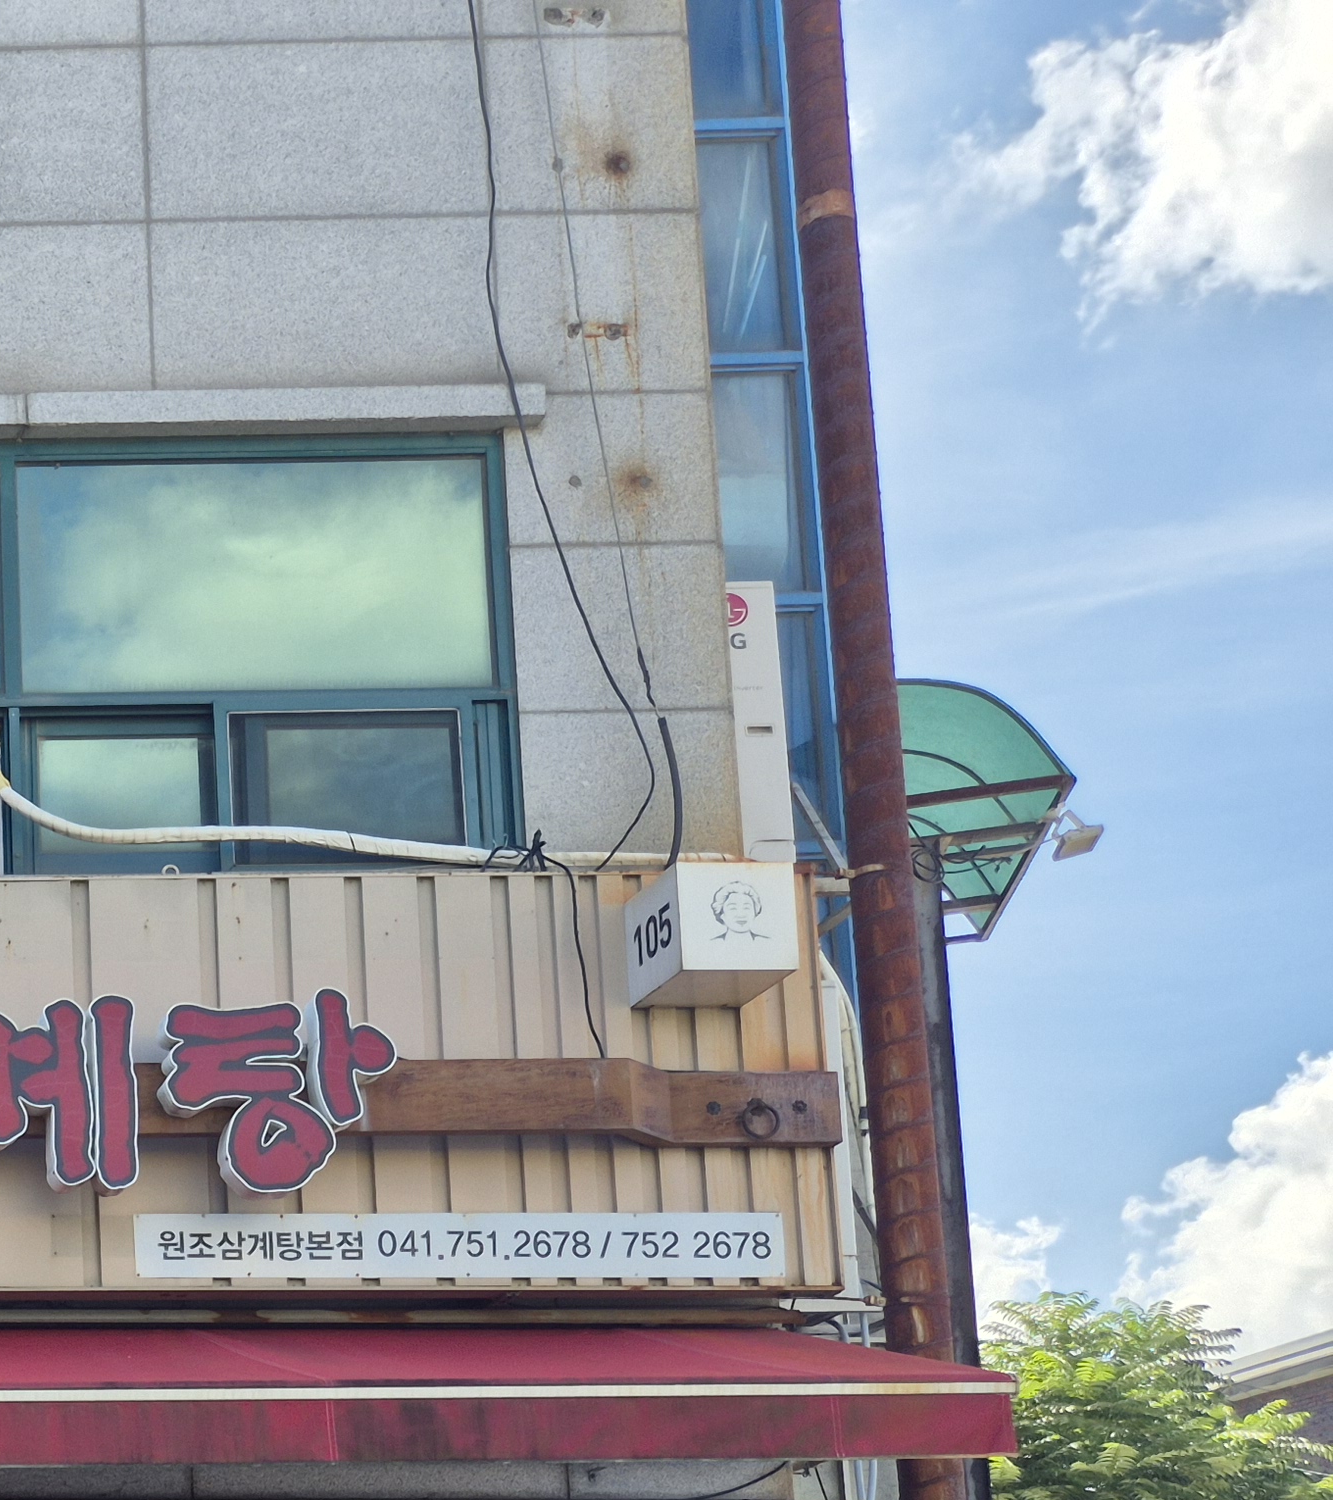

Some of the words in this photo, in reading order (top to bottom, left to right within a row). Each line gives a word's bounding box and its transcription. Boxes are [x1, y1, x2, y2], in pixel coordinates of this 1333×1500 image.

[633, 902, 673, 967] 105
[157, 1230, 365, 1262] 원조삼계탕본점
[376, 1229, 593, 1262] 041.751.2678
[621, 1230, 680, 1260] 752
[692, 1230, 773, 1260] 2678
